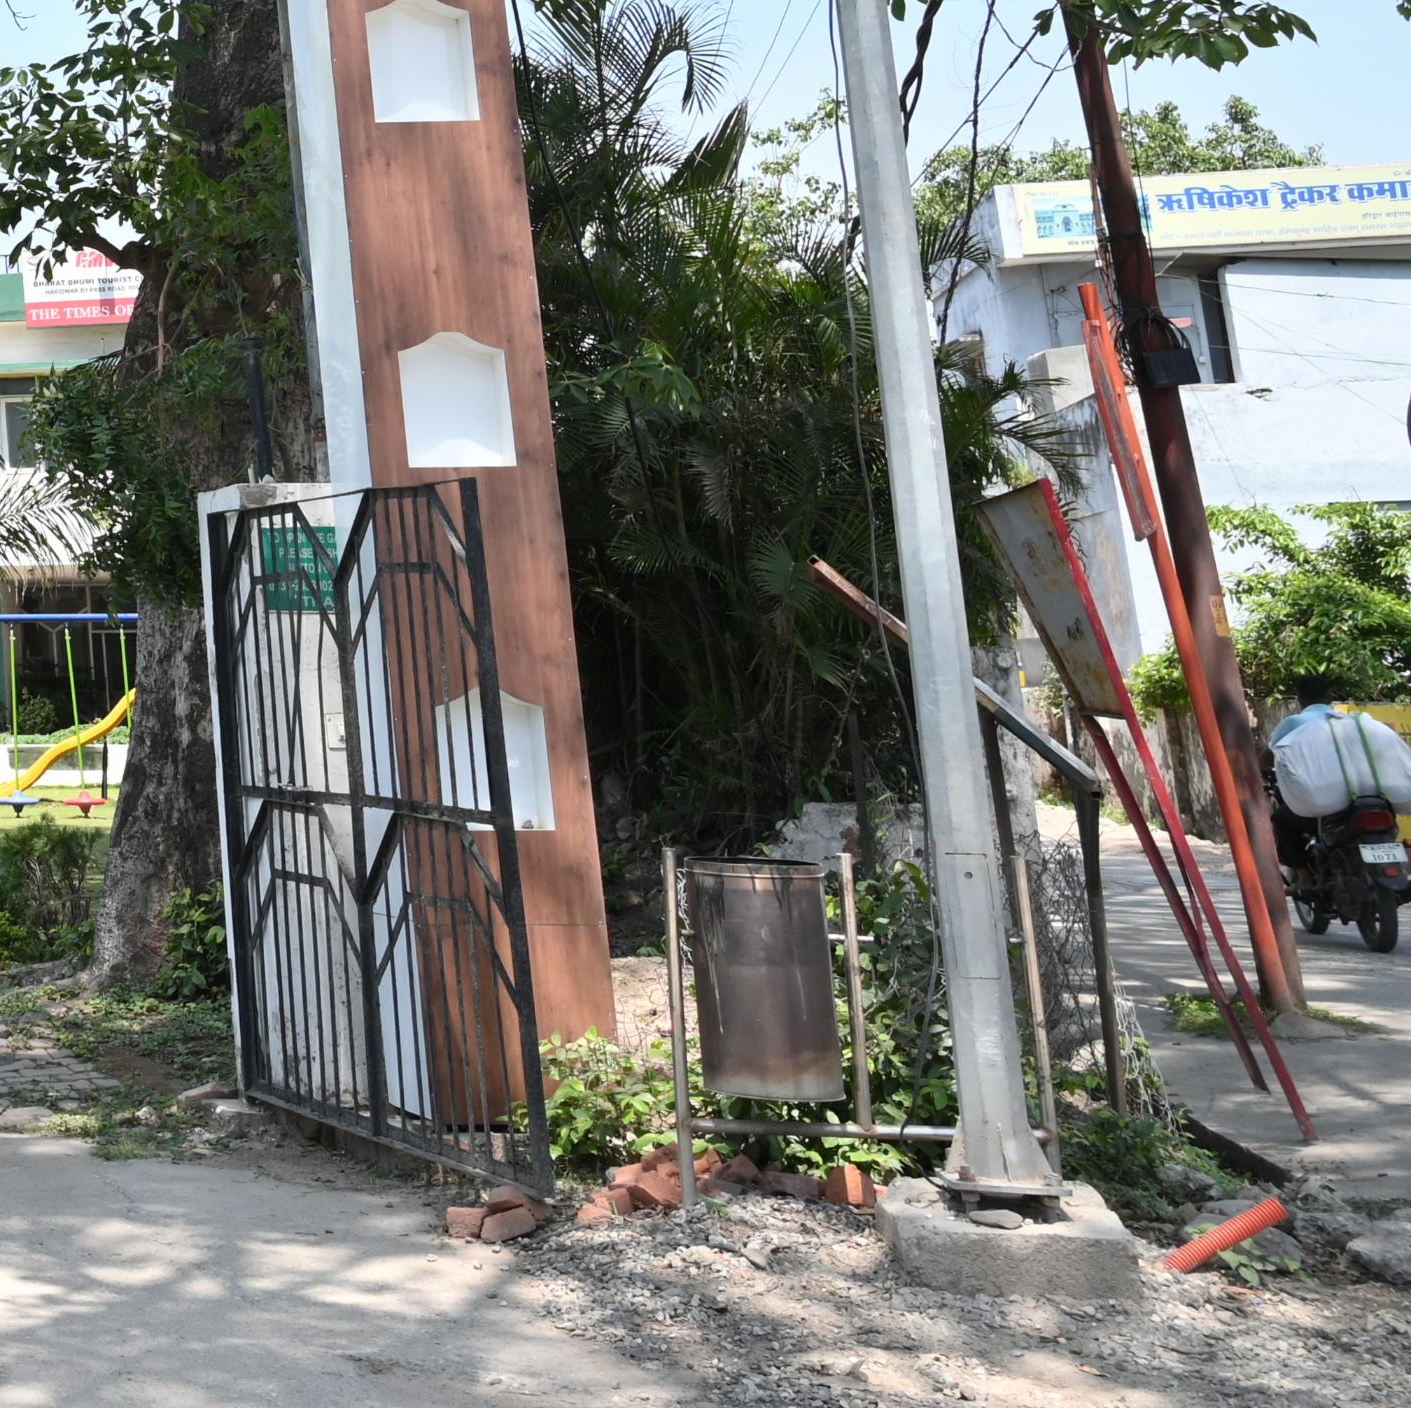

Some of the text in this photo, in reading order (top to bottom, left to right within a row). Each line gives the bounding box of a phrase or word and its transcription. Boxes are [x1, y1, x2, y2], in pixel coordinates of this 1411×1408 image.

[97, 276, 132, 284] TOURIST
[29, 308, 60, 320] THE
[63, 306, 110, 318] TIMES
